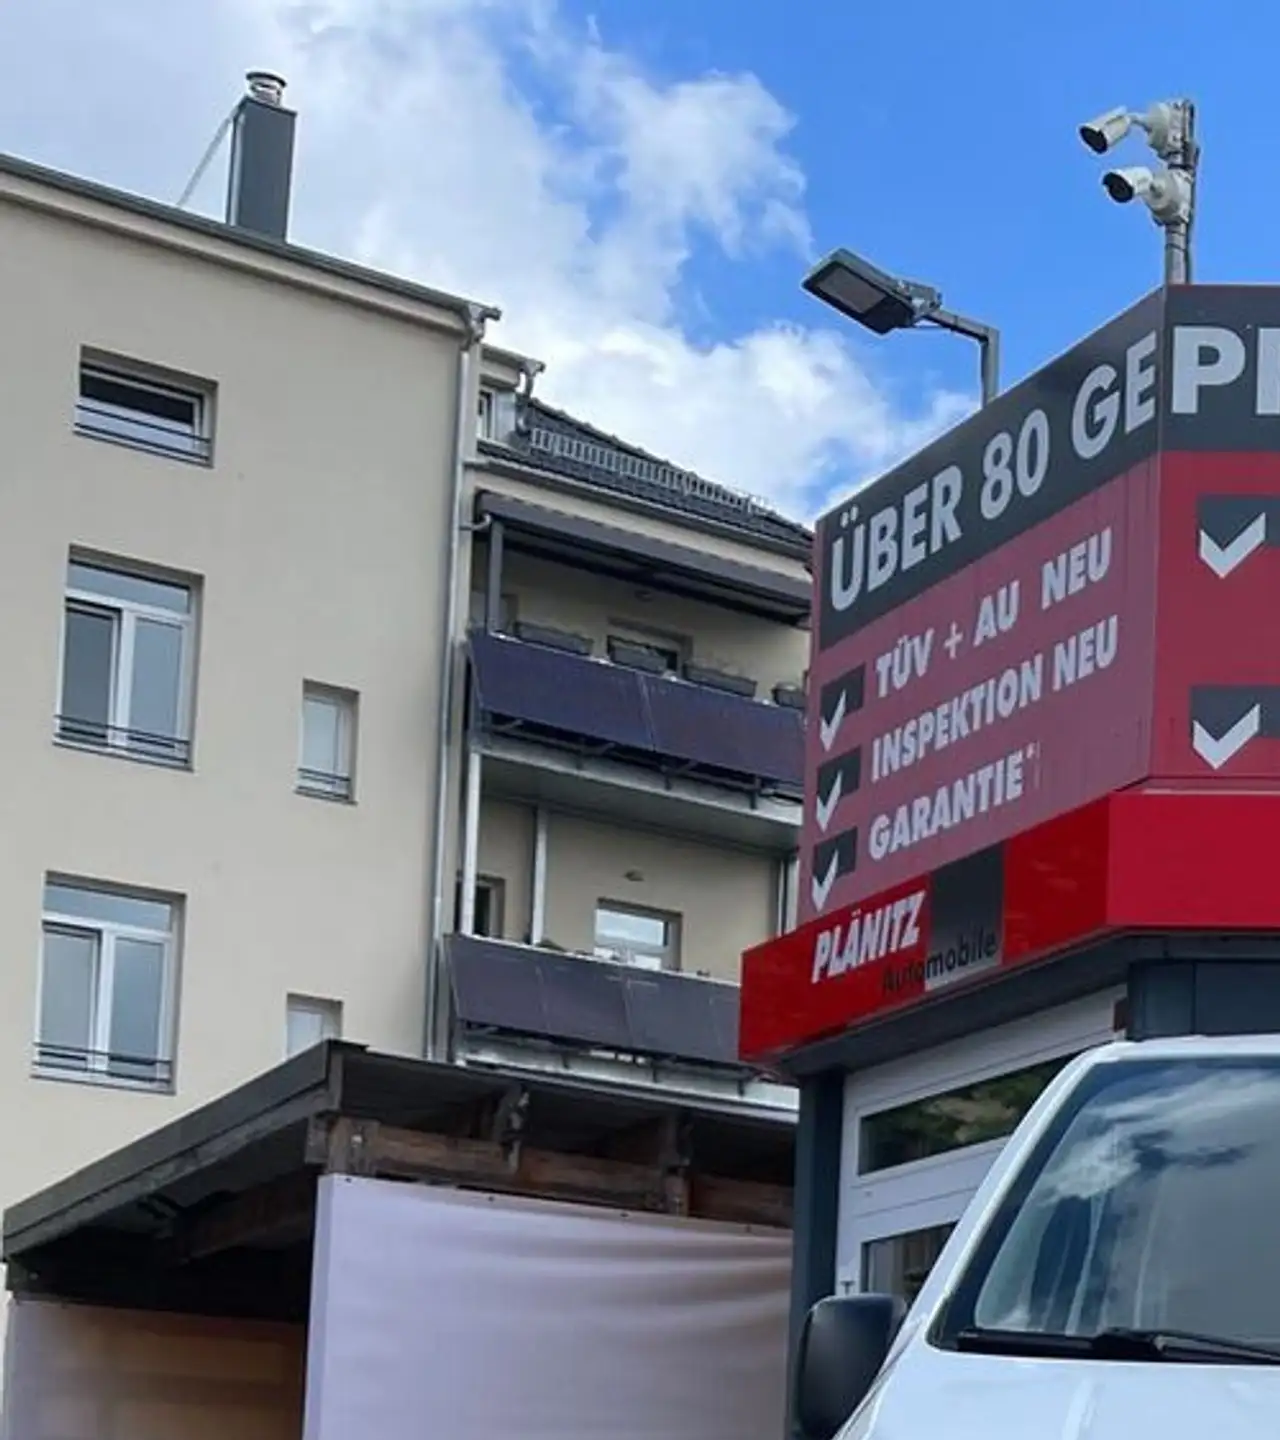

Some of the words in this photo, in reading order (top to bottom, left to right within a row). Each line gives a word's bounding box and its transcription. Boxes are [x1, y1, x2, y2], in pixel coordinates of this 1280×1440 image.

[830, 505, 964, 612] ÜBER
[980, 408, 1050, 521] 80
[876, 627, 936, 698] TÜV
[944, 622, 964, 660] +
[973, 580, 1020, 646] AU
[1041, 527, 1112, 609] NEU
[871, 654, 1043, 784] INSPEKTION
[1053, 615, 1119, 692] NEU
[811, 890, 926, 983] PLÄNITZ
[882, 925, 998, 994] Automobile
